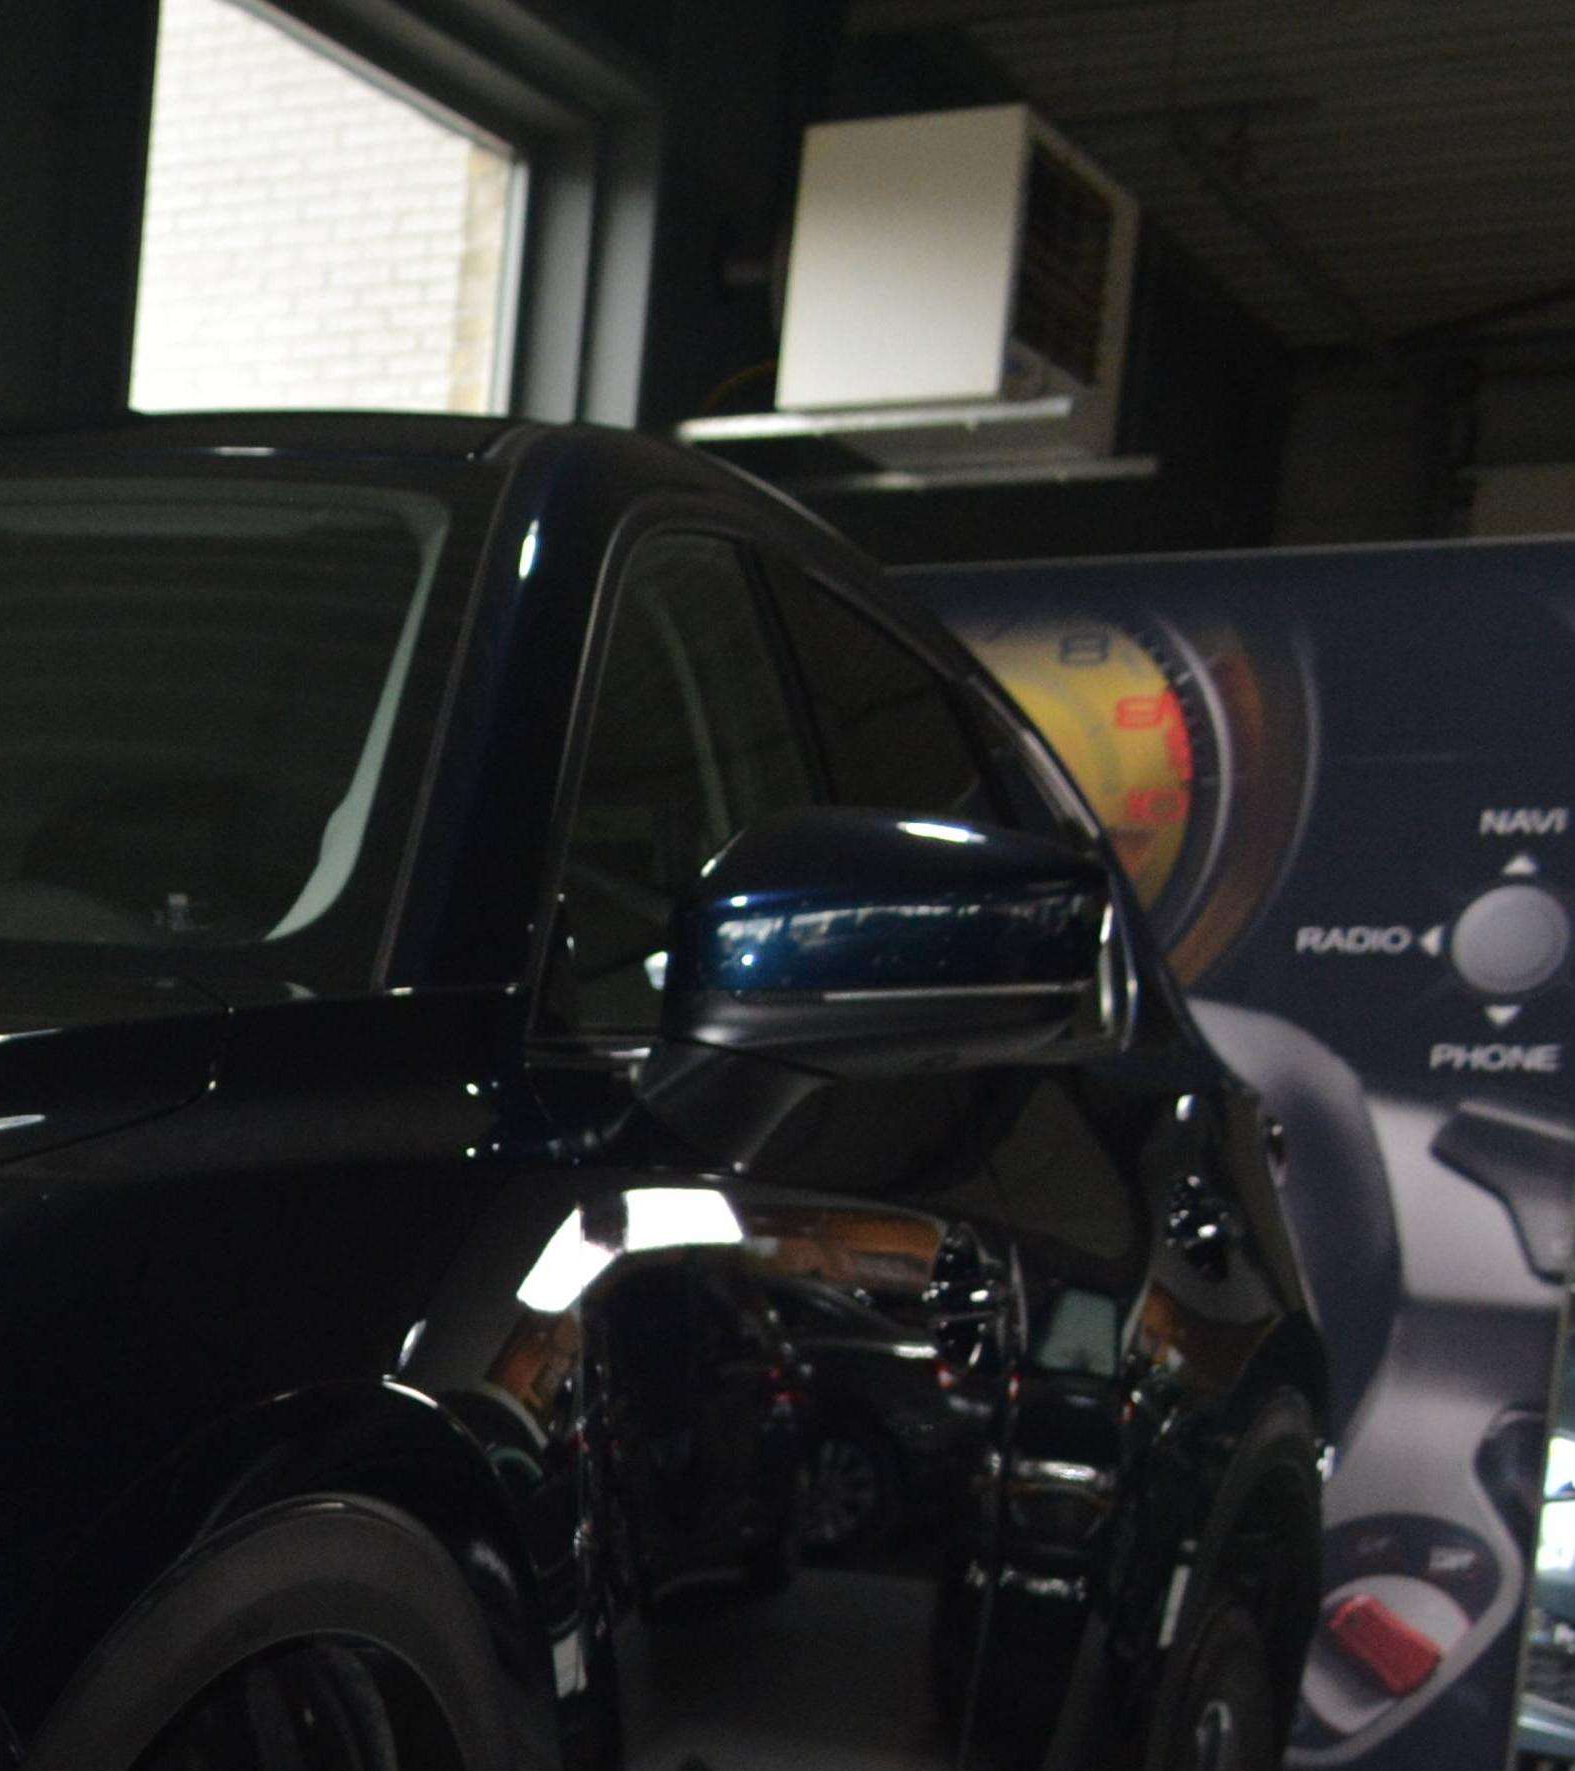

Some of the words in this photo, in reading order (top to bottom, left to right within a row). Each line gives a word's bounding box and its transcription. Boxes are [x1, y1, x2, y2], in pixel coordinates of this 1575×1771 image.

[1480, 808, 1568, 835] NAVI
[1296, 925, 1414, 955] RADIO
[1430, 1043, 1562, 1072] PHONE
